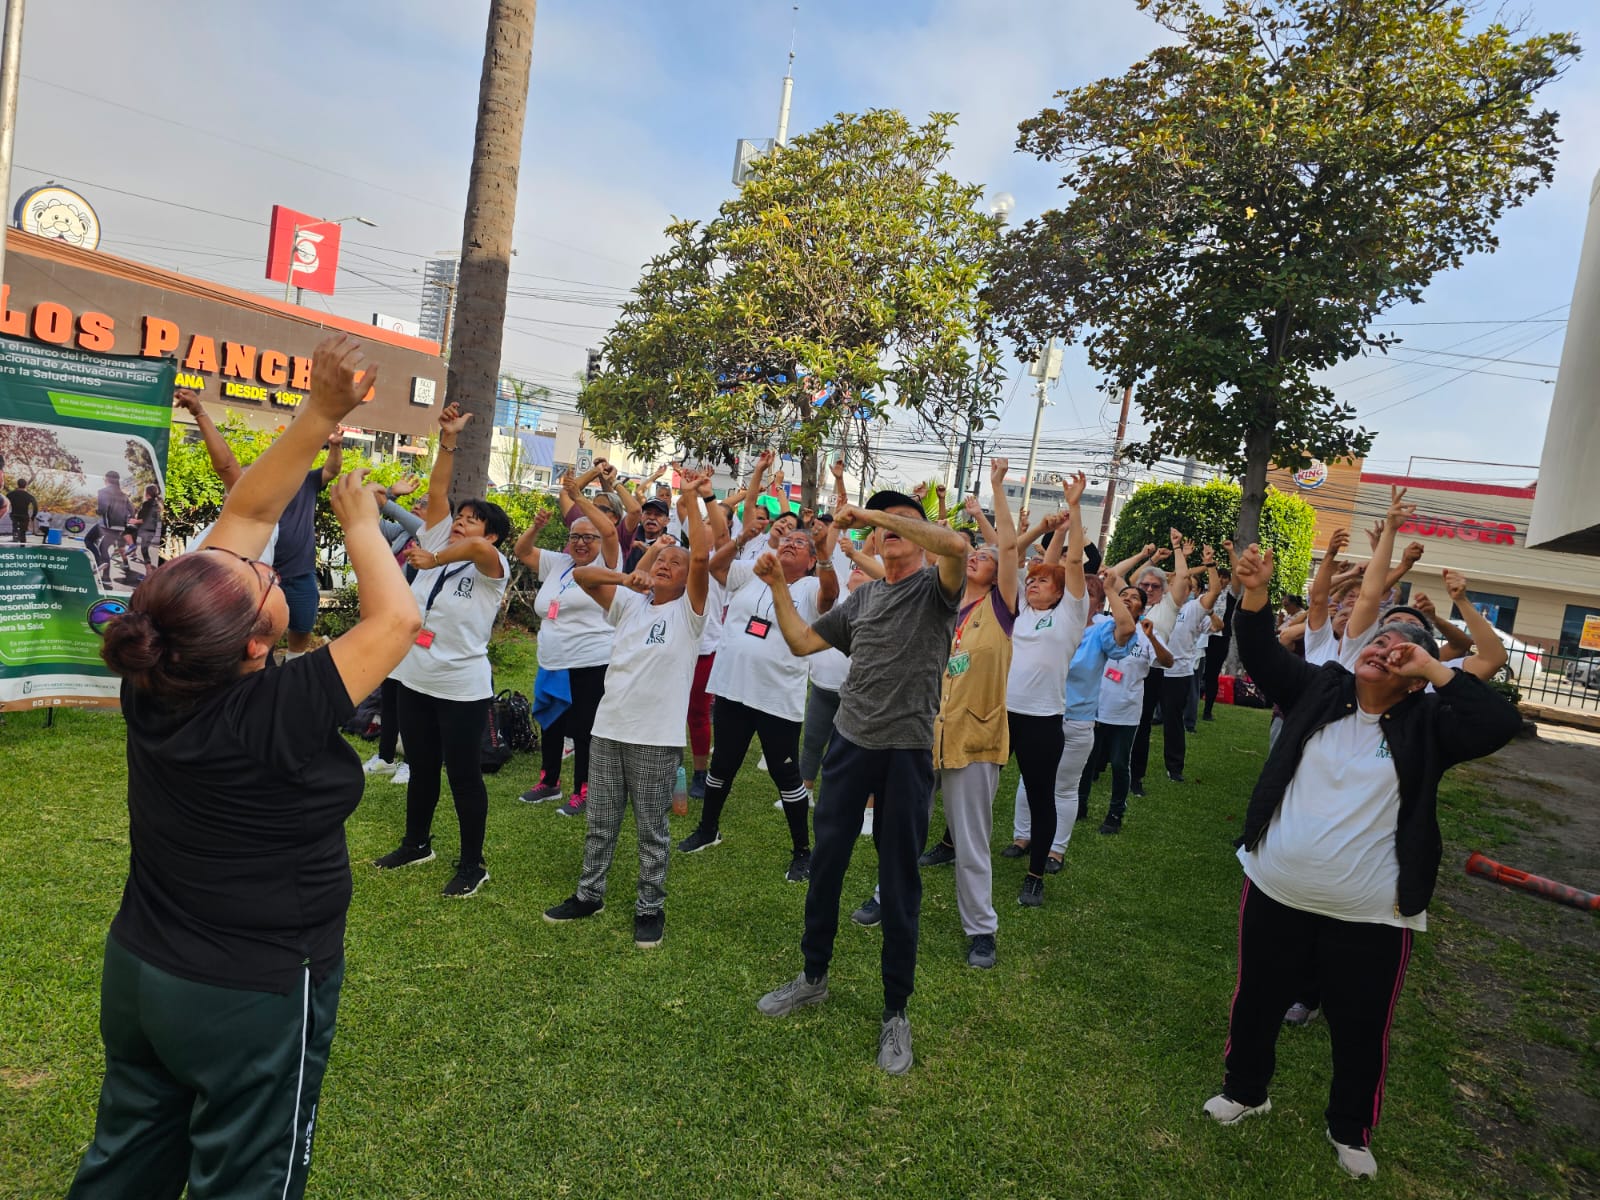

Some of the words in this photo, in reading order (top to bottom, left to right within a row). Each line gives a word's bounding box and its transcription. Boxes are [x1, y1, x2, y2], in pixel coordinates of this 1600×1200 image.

[0, 284, 115, 352] LOS
[9, 342, 19, 352] el
[22, 346, 59, 358] marco
[61, 350, 78, 361] del
[81, 354, 136, 369] Programa
[0, 353, 40, 366] acional
[42, 357, 58, 368] de
[61, 362, 123, 378] Activación
[126, 370, 158, 384] Física
[0, 366, 15, 375] ara
[19, 366, 30, 377] la
[33, 369, 102, 387] Salud-IMSS
[174, 373, 205, 390] ANA
[226, 382, 267, 401] DESDE
[275, 391, 303, 407] 1967
[1398, 514, 1516, 544] BURGER
[5, 561, 28, 569] activo
[25, 553, 48, 561] invita
[0, 593, 36, 602] rograma
[17, 623, 26, 631] la
